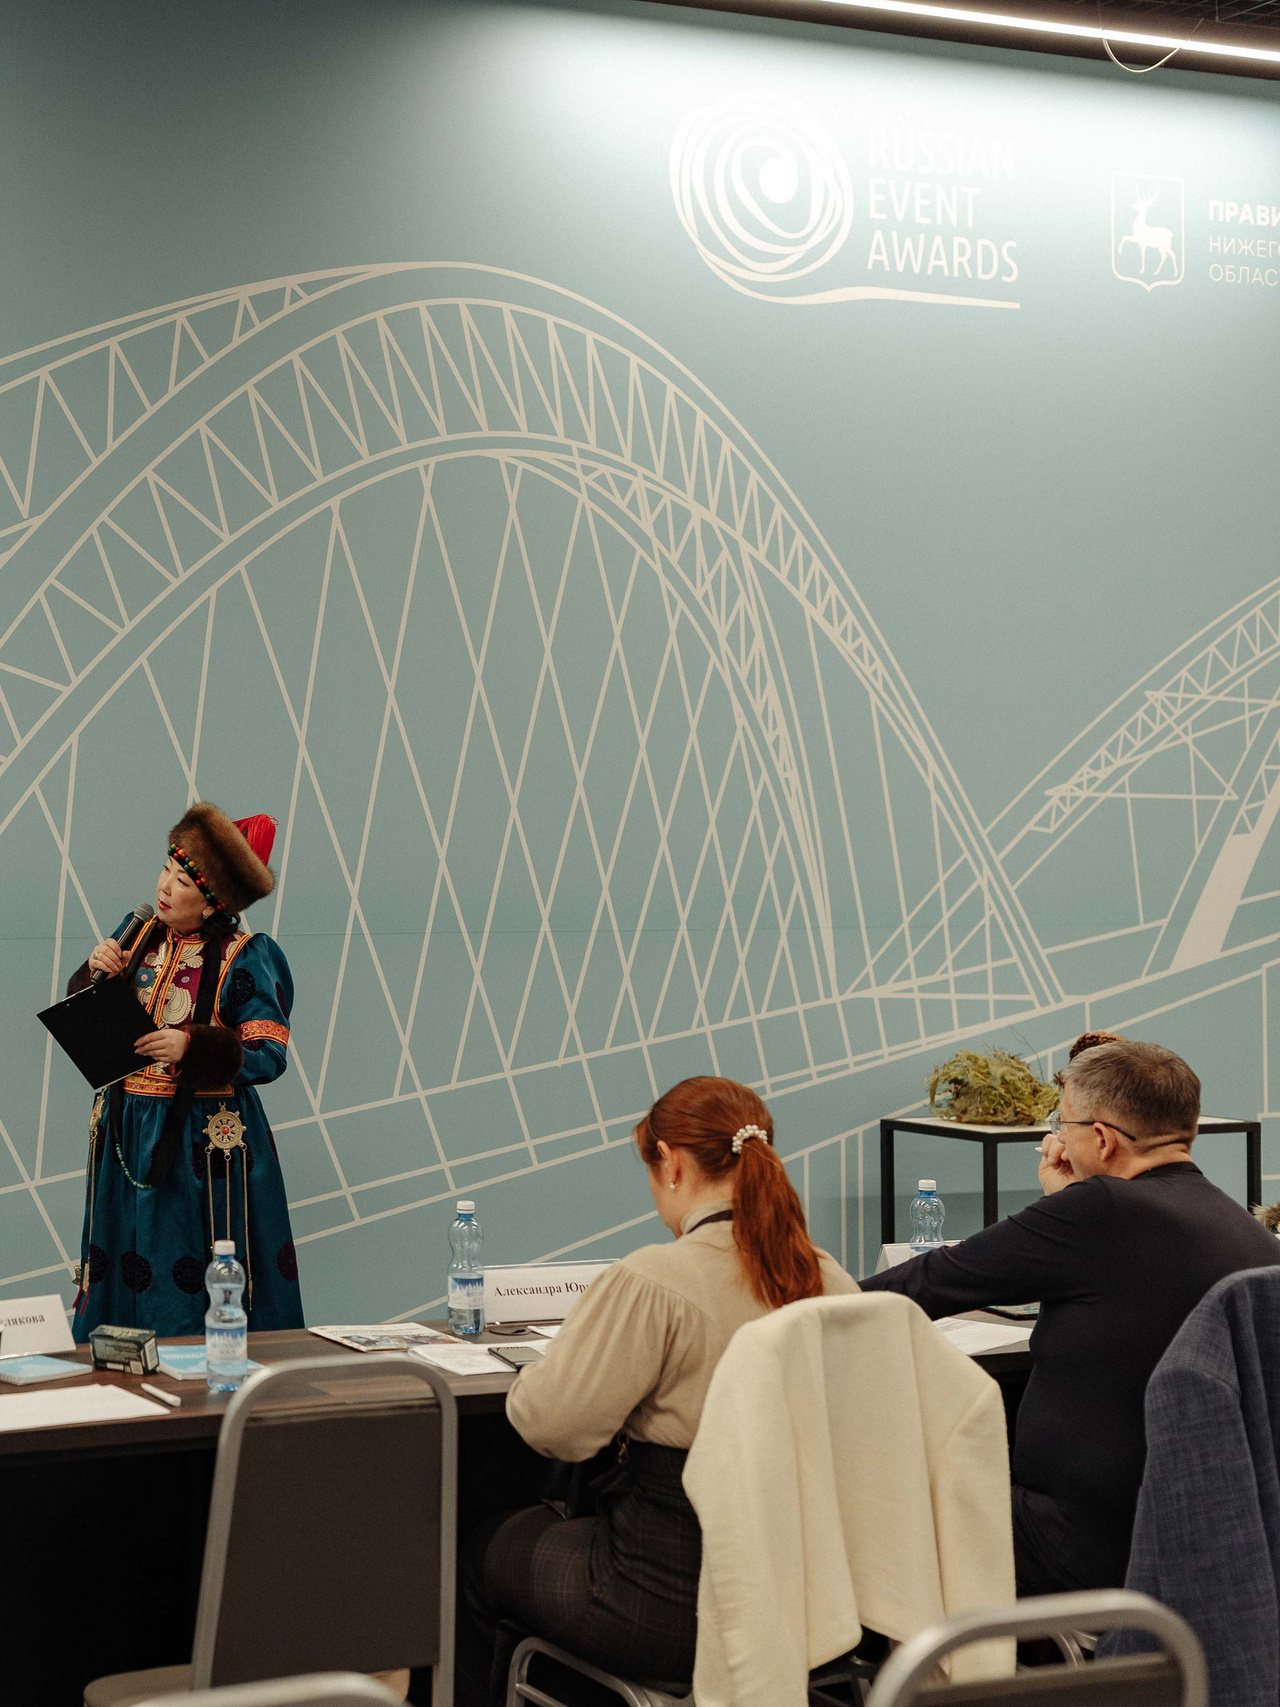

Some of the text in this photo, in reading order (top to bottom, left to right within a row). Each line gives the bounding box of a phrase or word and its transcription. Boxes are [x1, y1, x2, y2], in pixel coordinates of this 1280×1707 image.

[869, 124, 1015, 181] RUSSIAN
[868, 177, 981, 229] EVENT
[866, 229, 1019, 283] AWARDS
[1208, 235, 1280, 258] НИЖЕГ
[494, 1284, 562, 1297] Александра
